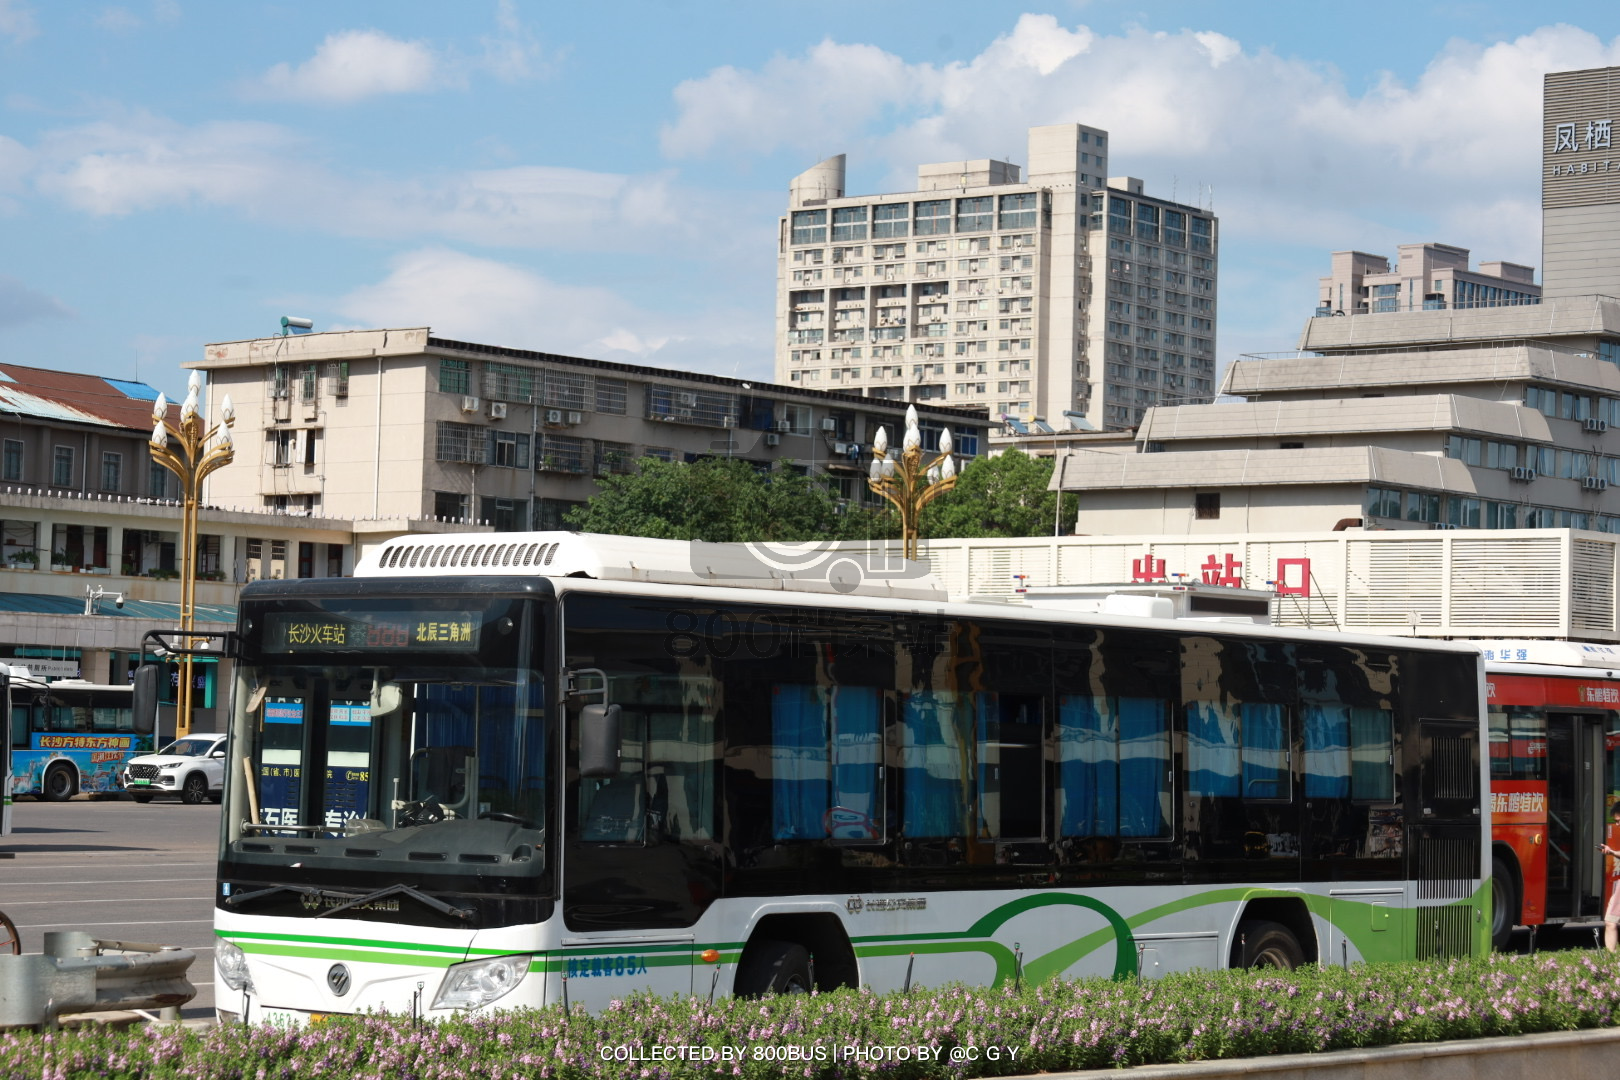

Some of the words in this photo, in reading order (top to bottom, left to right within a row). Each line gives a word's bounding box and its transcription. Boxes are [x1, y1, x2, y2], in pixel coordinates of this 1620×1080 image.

[1553, 120, 1612, 153] 凤栖
[1131, 553, 1311, 598] 出站口
[289, 623, 346, 644] 长沙火车站
[416, 622, 471, 642] 北辰三角洲
[1586, 686, 1619, 702] 东鹏特饮
[40, 736, 130, 748] 长沙方特东方神画
